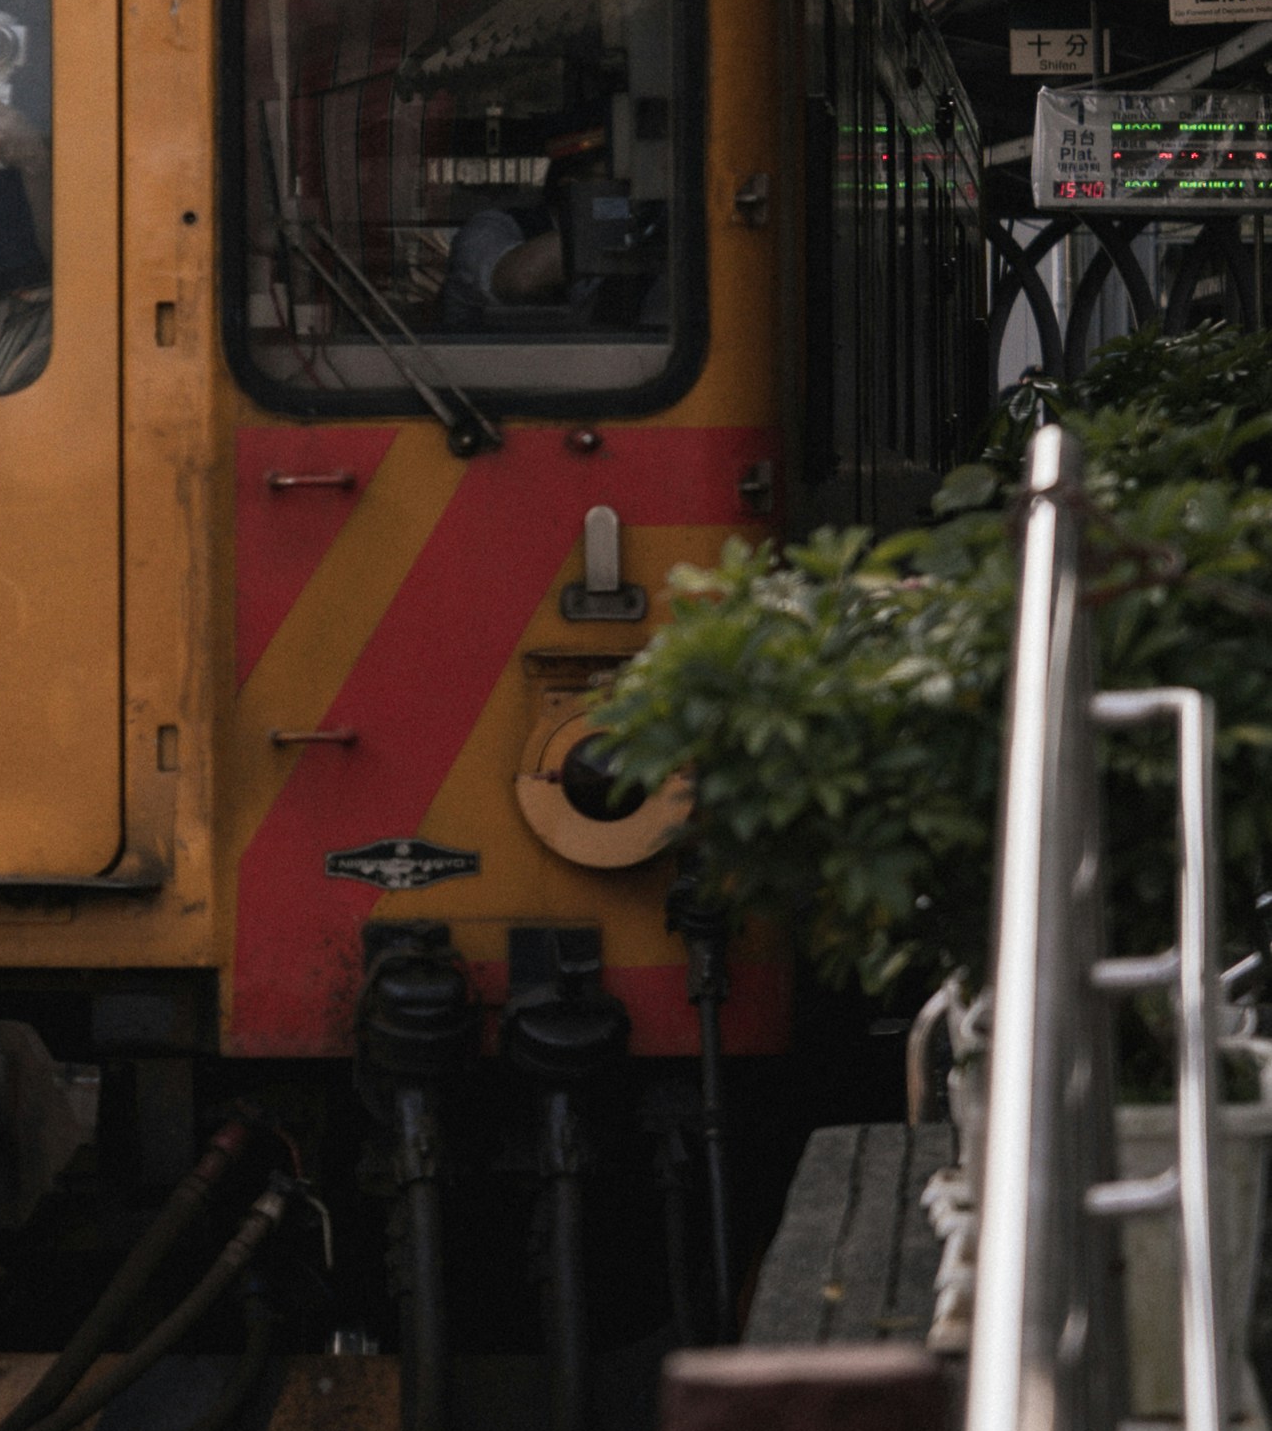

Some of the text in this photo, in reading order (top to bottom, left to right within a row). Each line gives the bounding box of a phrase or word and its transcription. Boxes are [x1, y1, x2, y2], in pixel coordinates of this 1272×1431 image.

[1039, 59, 1077, 71] Shifen
[1063, 129, 1095, 146] 月台
[1060, 147, 1097, 160] Plat.
